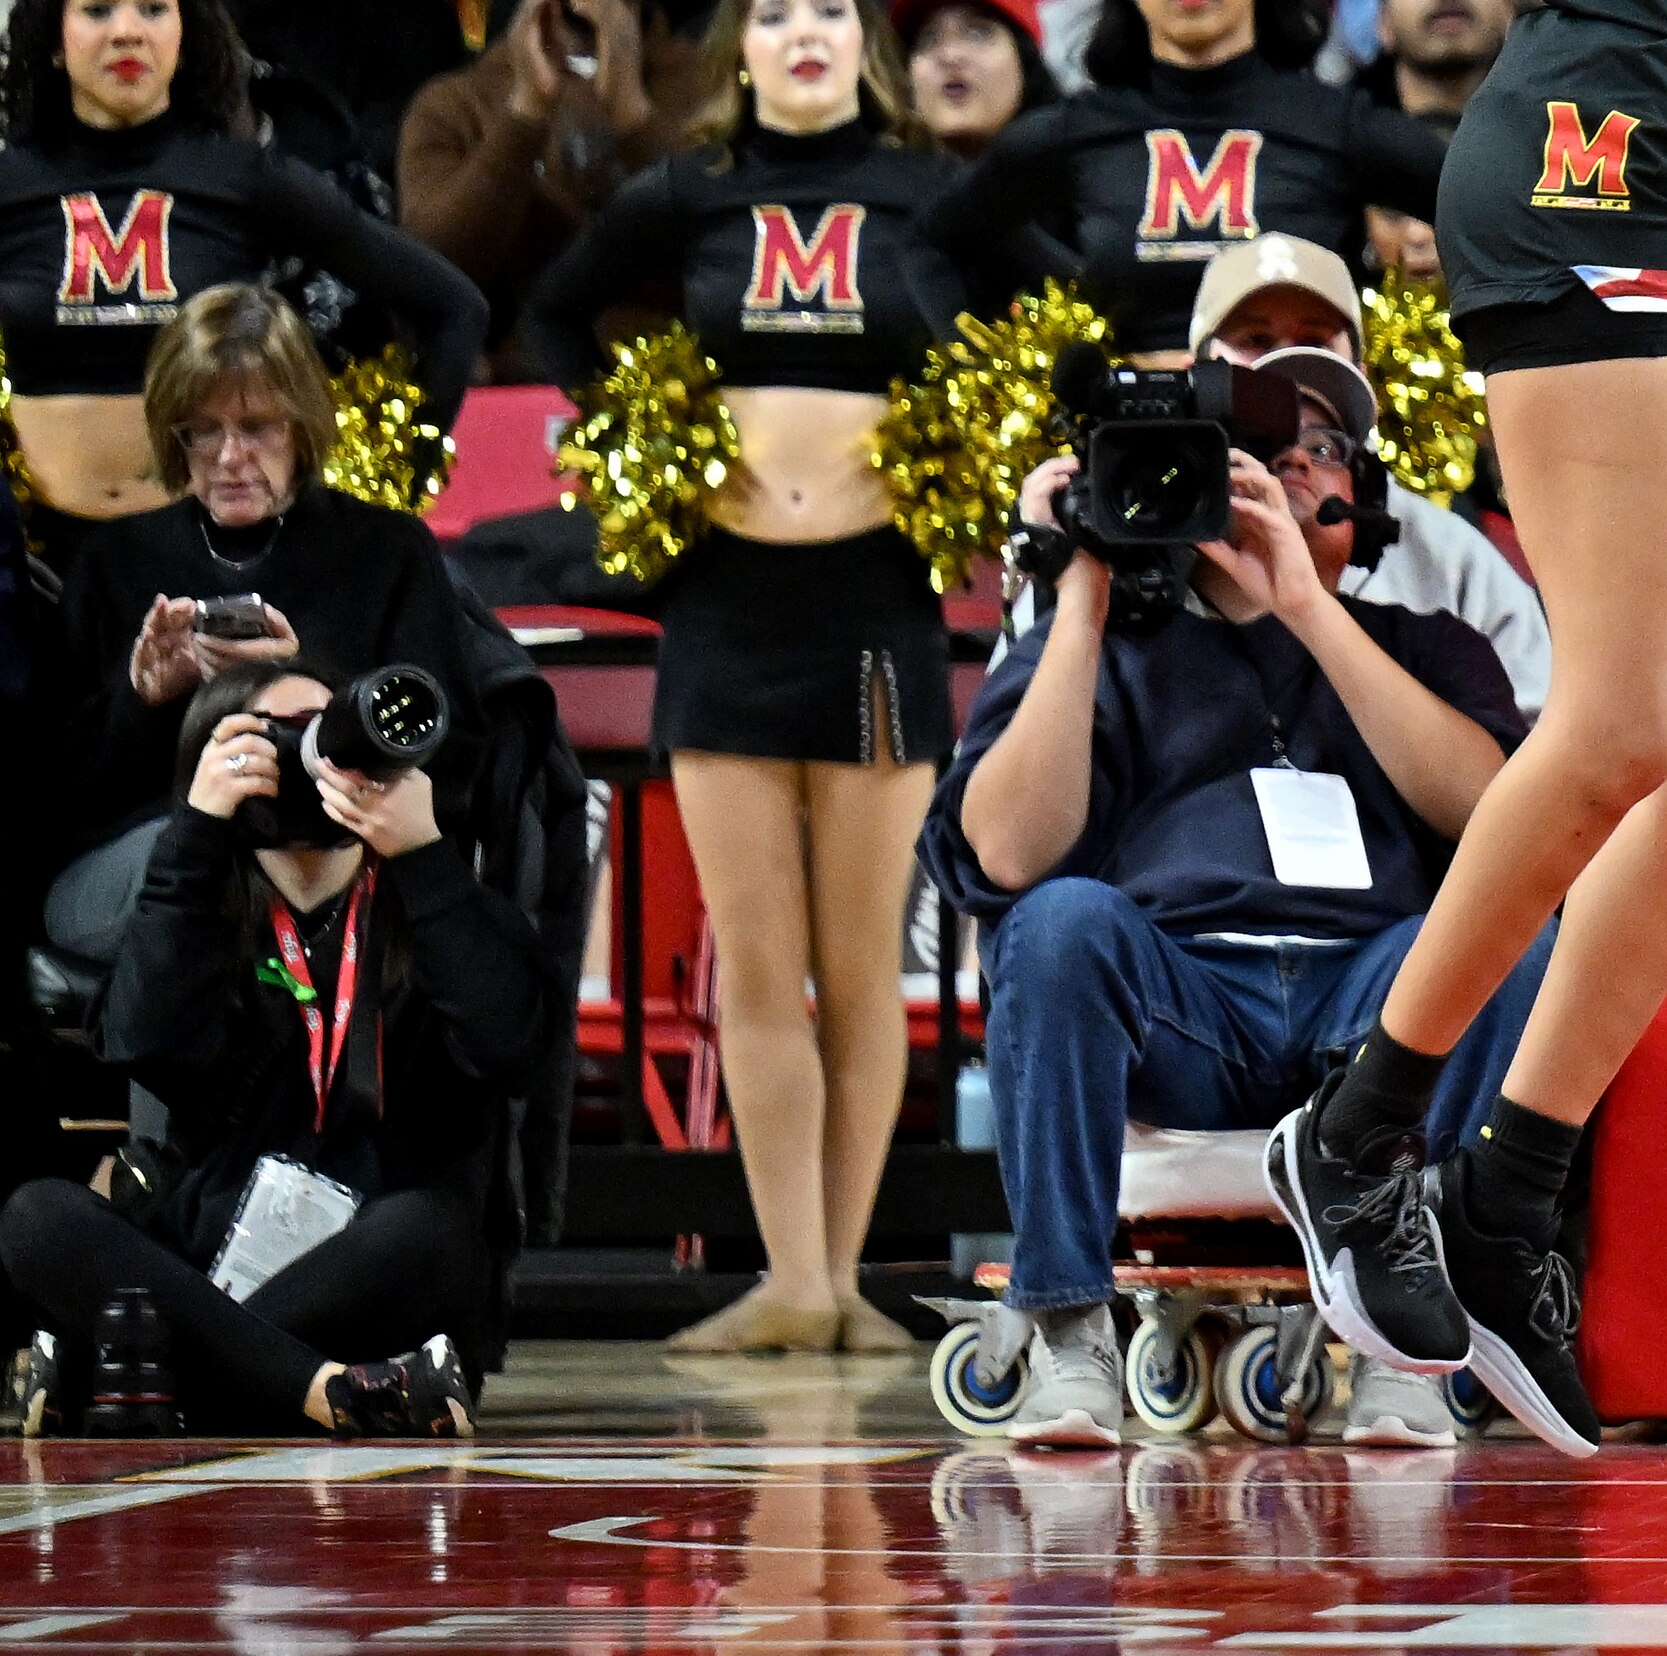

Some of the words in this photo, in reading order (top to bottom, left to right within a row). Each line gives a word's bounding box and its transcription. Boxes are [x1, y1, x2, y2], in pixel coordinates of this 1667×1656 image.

[1137, 129, 1264, 241] M
[1533, 101, 1641, 196] M
[57, 188, 179, 305] M
[742, 202, 867, 311] M
